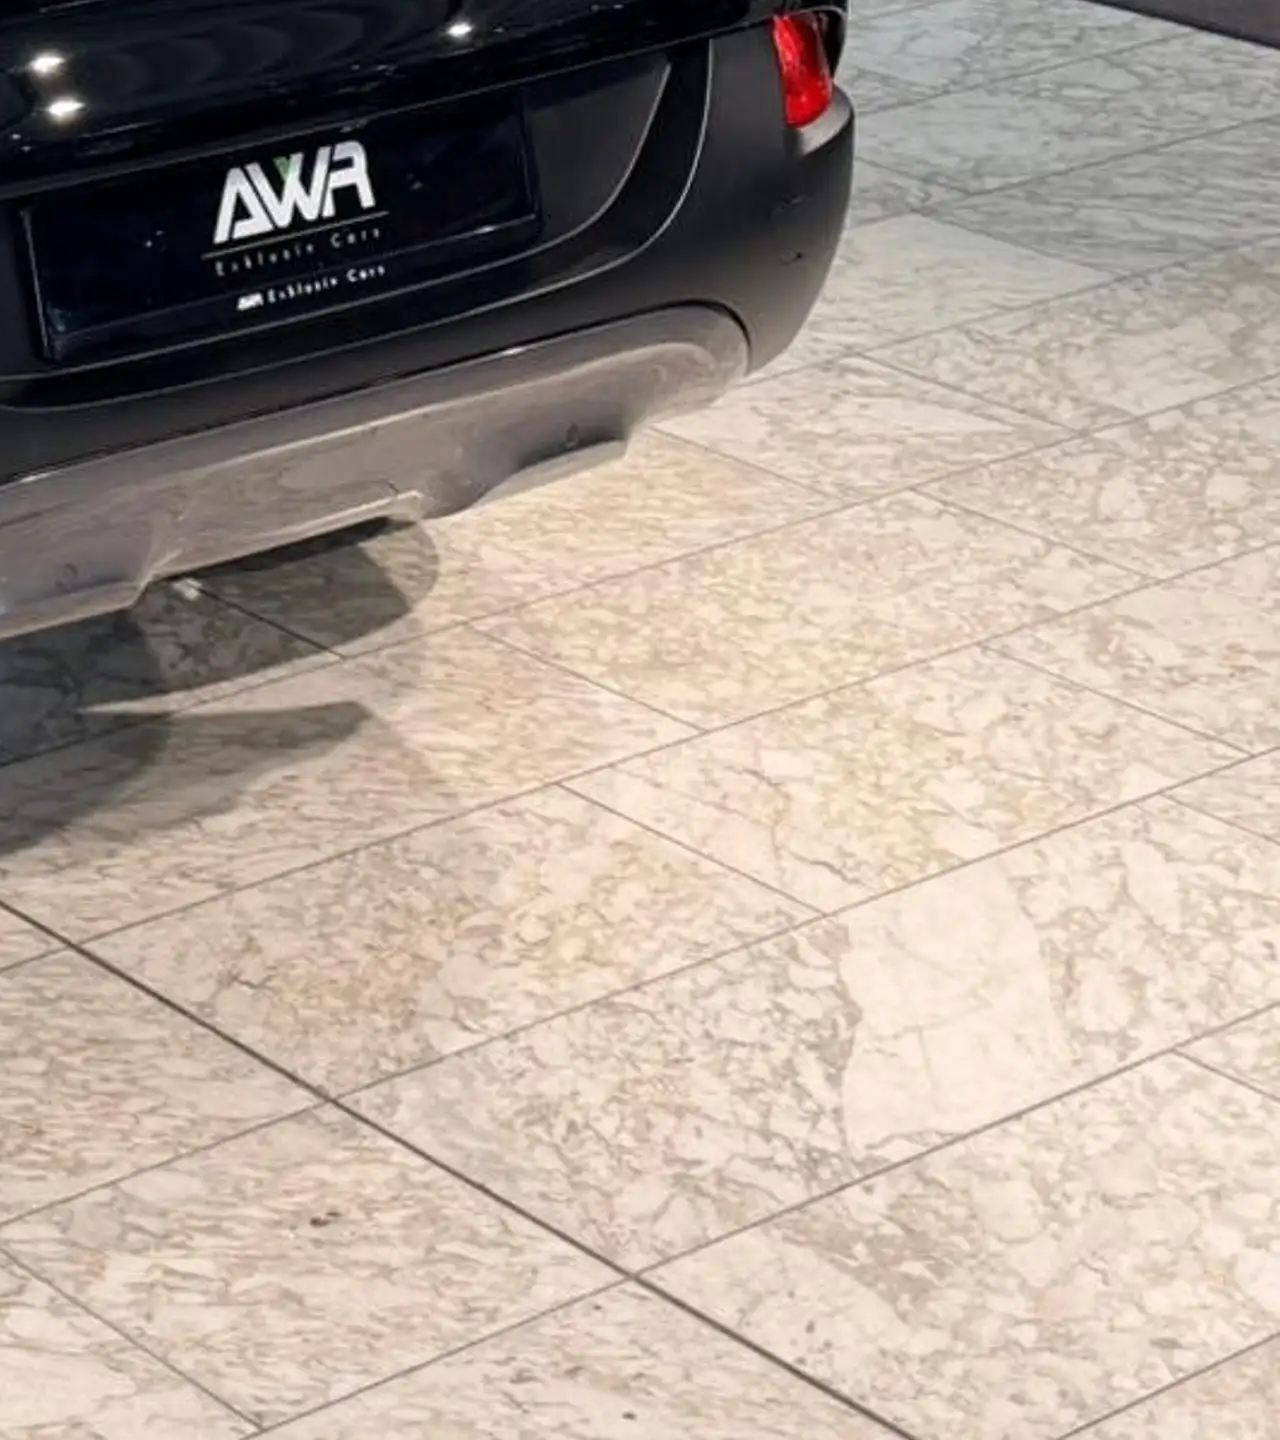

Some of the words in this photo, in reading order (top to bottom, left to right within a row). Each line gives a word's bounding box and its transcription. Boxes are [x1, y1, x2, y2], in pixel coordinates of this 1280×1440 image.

[212, 139, 377, 245] AWR
[330, 227, 381, 249] Cars
[346, 264, 386, 283] Cars
